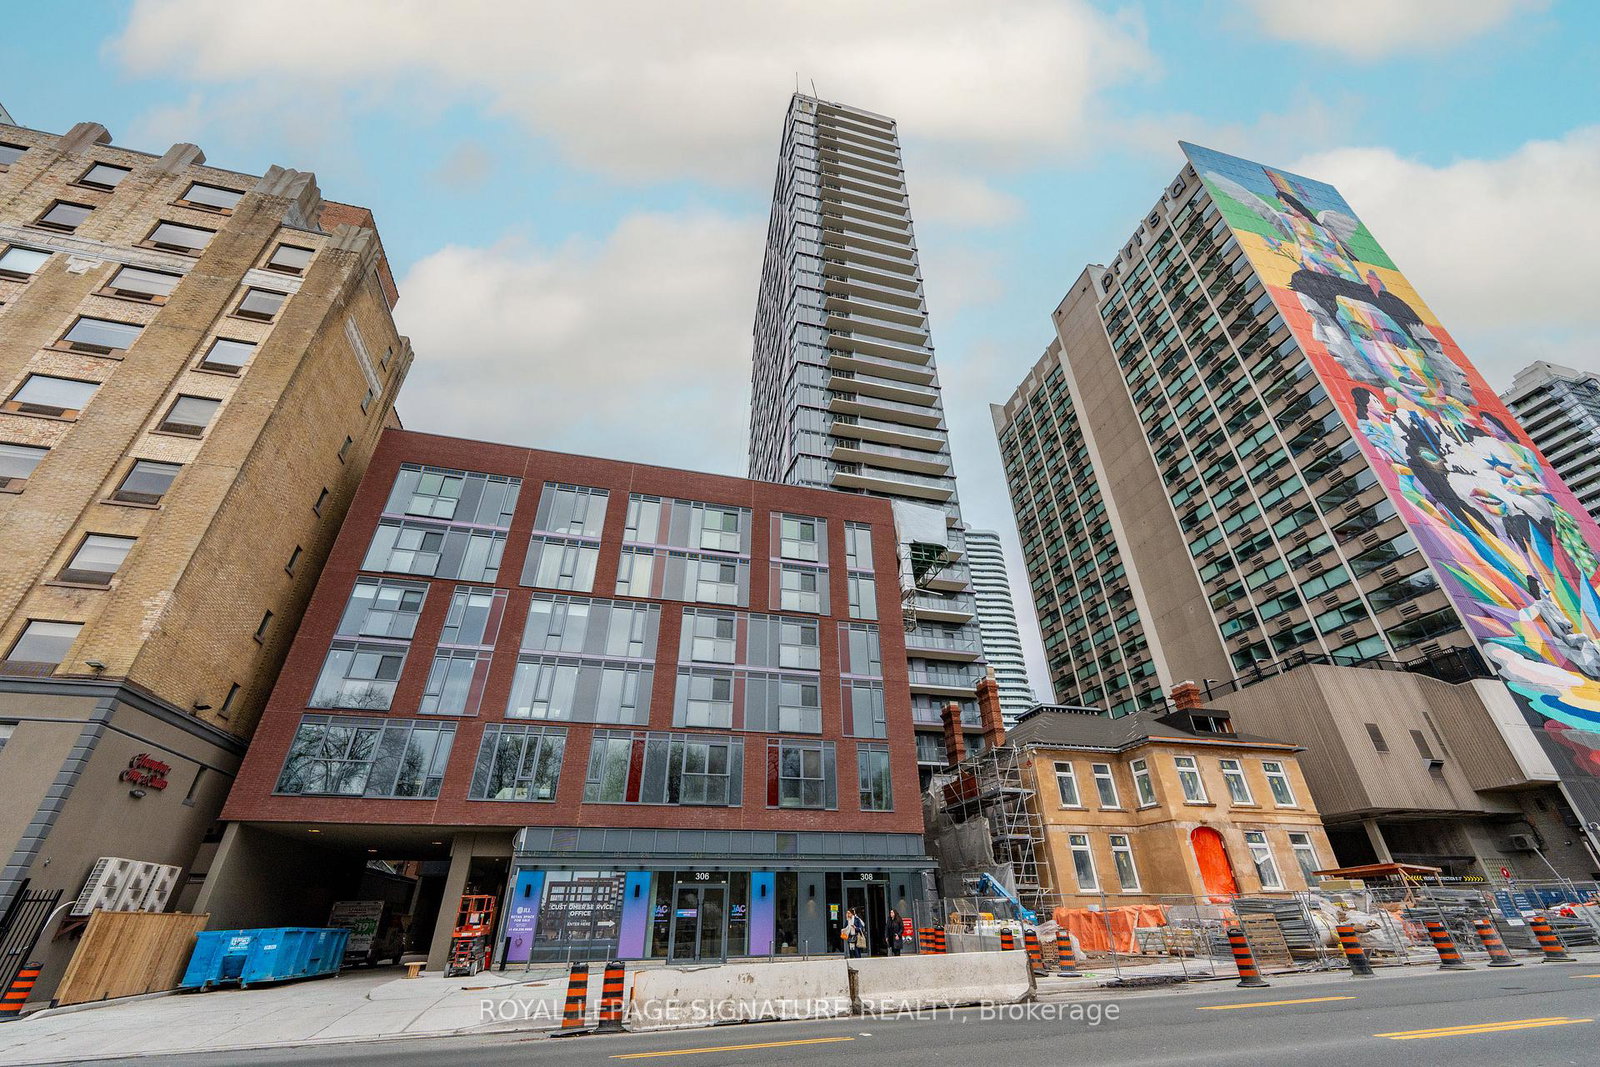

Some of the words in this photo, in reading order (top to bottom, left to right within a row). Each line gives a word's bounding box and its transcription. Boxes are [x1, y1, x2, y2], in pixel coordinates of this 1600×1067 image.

[695, 872, 710, 880] 306
[860, 873, 873, 881] 308
[731, 905, 746, 913] JAC
